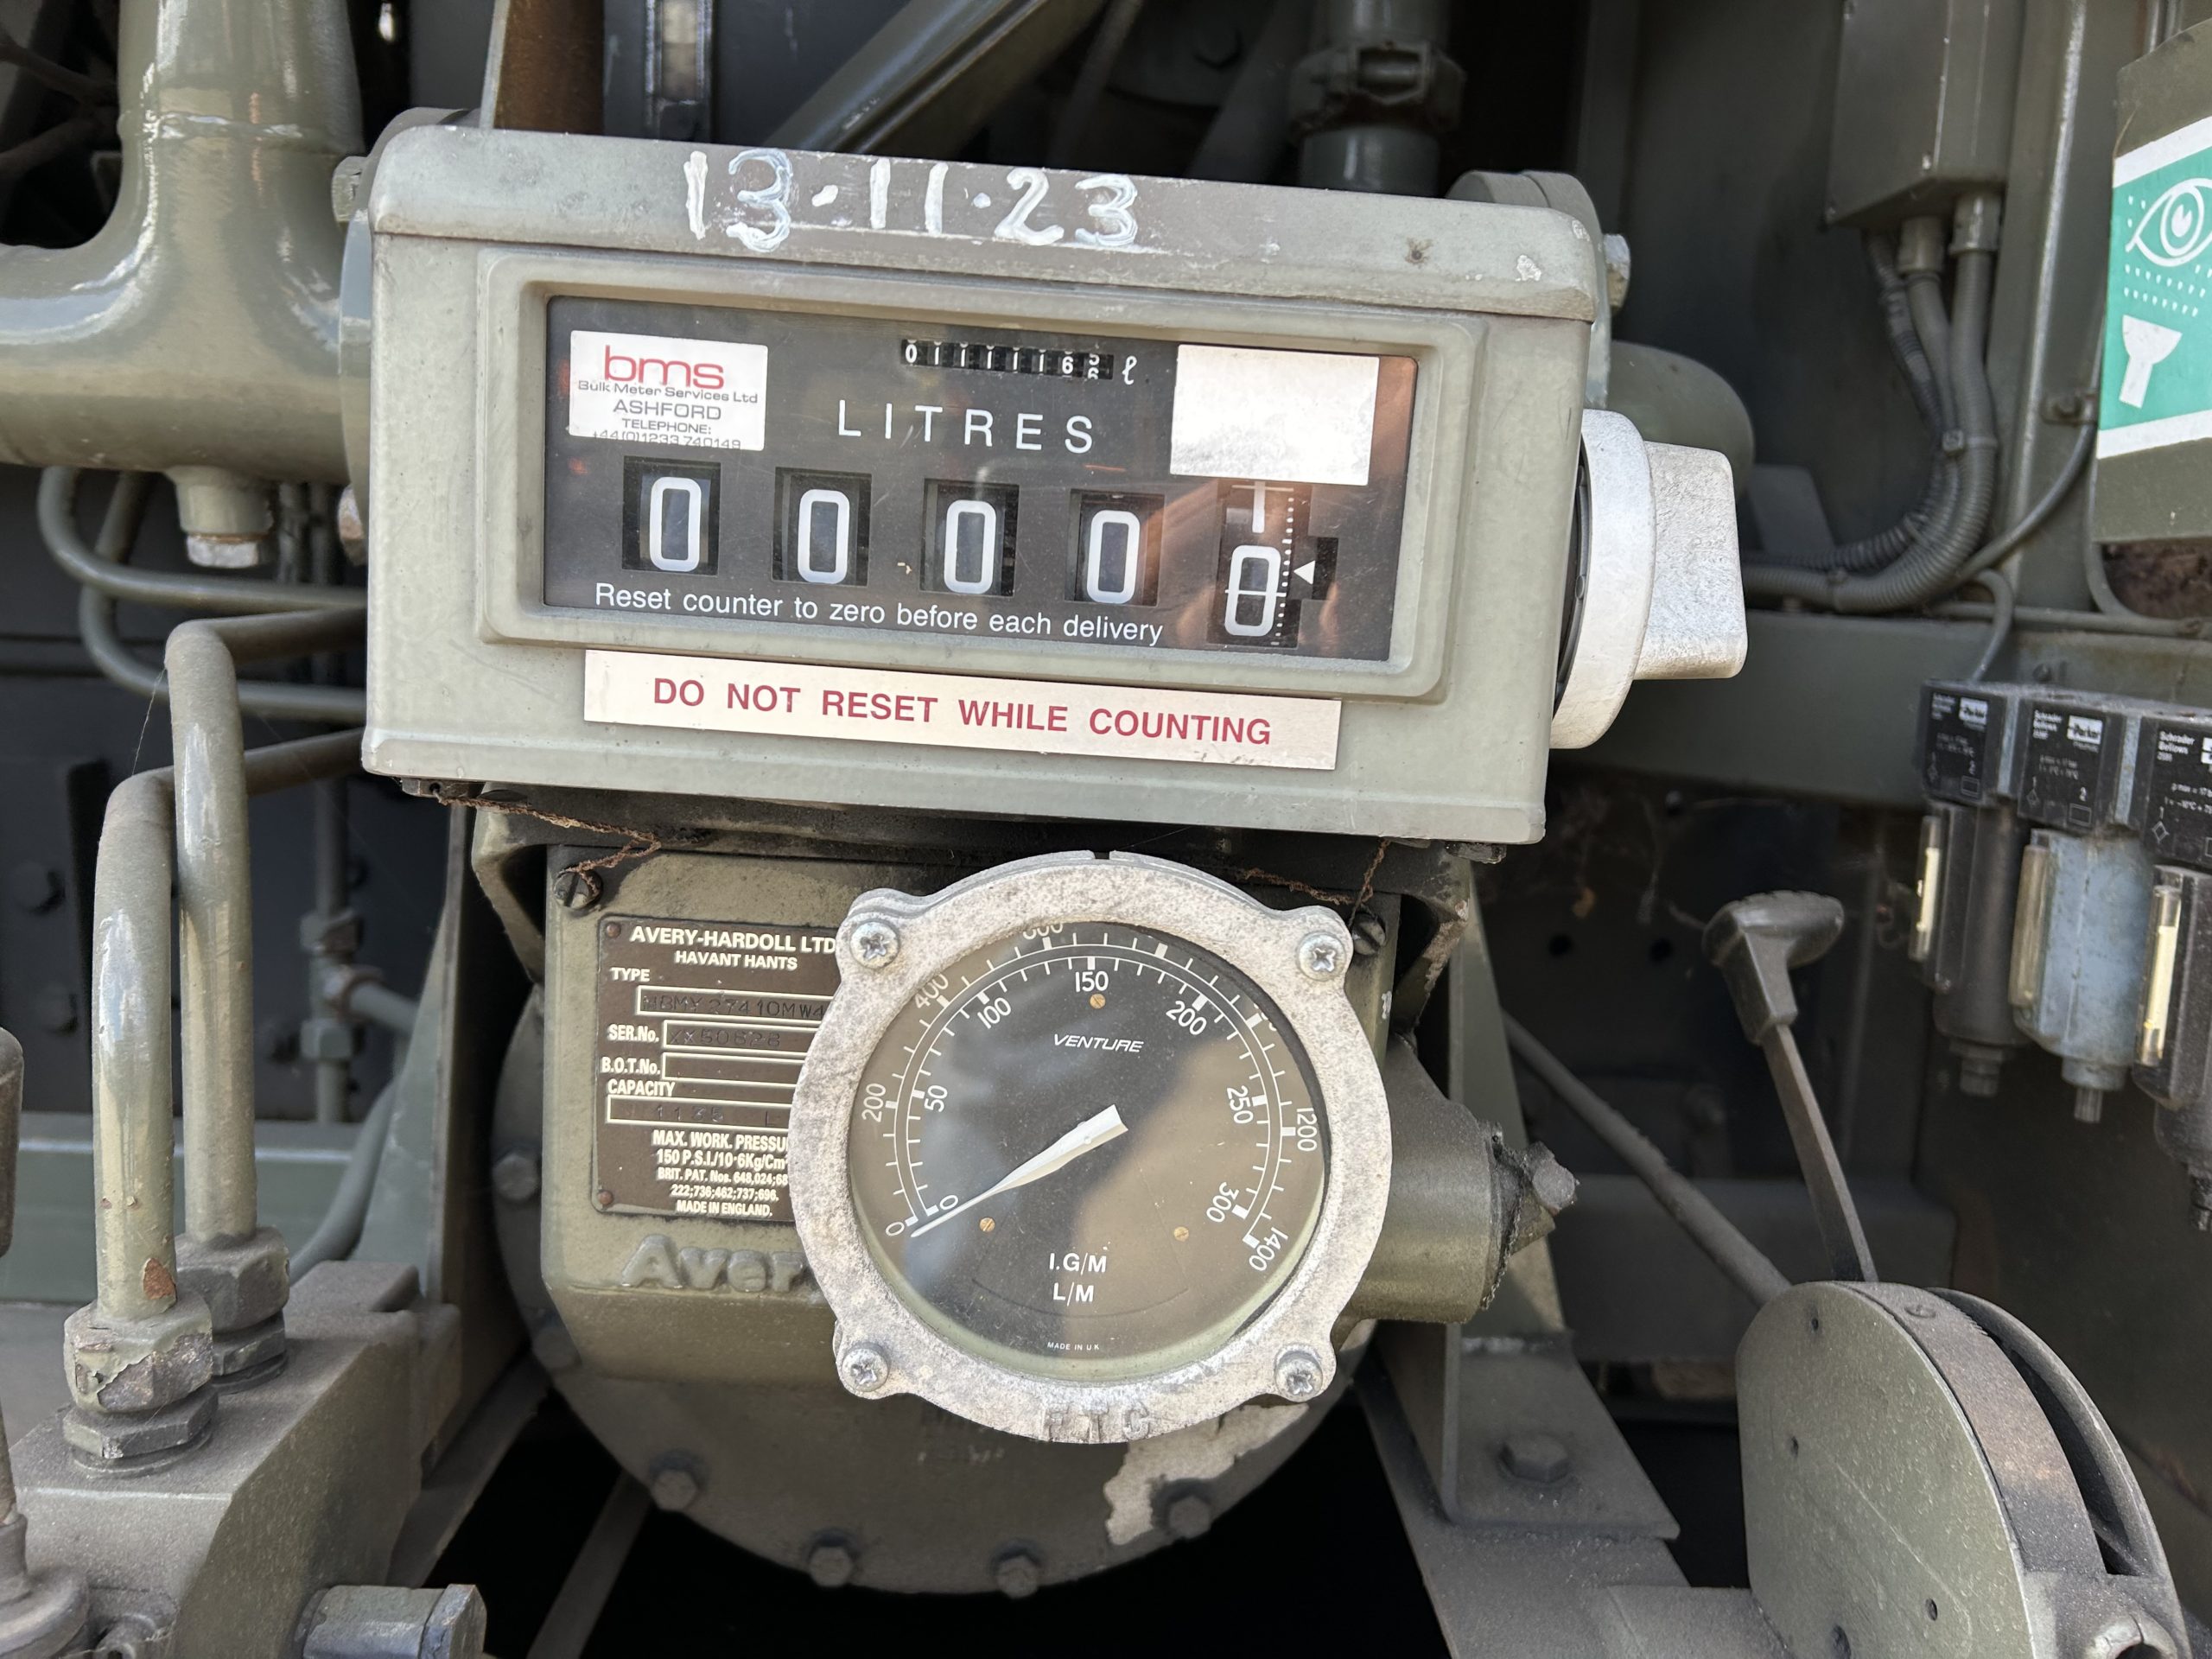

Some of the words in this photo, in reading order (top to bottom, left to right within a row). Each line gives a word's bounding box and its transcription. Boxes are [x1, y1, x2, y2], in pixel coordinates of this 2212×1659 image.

[605, 345, 724, 389] bms
[578, 380, 610, 391] Bulk
[614, 383, 661, 396] Meter
[664, 387, 729, 401] Services
[734, 391, 758, 404] Ltd
[613, 399, 721, 420] ASHFORD
[622, 418, 711, 435] TELEPHONE:
[838, 399, 1093, 454] LITRES
[595, 582, 671, 610] Reset
[683, 593, 784, 617] counter
[794, 597, 818, 619] to
[830, 603, 885, 624] zero
[897, 602, 977, 630] before
[989, 612, 1051, 635] each
[1063, 614, 1163, 646] delivery
[654, 677, 704, 706] DO
[728, 683, 801, 713] NOT
[823, 690, 938, 722] RESET
[958, 699, 1068, 732] WHILE
[1090, 709, 1270, 745] COUNTING
[629, 925, 796, 951] AVERY-HARDOLL
[675, 950, 741, 967] HAVANT
[744, 955, 798, 970] HANTS
[611, 967, 650, 982] TYPE
[1075, 970, 1109, 992] 150
[977, 997, 1012, 1029] 100
[1166, 1001, 1207, 1035] 200
[608, 1023, 659, 1043] SER.No.
[1054, 1033, 1144, 1052] VENTURE
[601, 1057, 660, 1075] B.O.T.No.
[607, 1078, 676, 1097] CAPACITY
[924, 1085, 948, 1112] 50
[861, 1083, 887, 1122] 200
[1227, 1085, 1254, 1124] 250
[652, 1129, 688, 1147] MAX.
[690, 1132, 733, 1149] WORK.
[735, 1135, 788, 1152] PRESSU
[1296, 1108, 1318, 1152] 1200
[657, 1148, 680, 1165] 150
[658, 1166, 683, 1180] BRIT.
[685, 1168, 708, 1182] PAT.
[710, 1170, 732, 1183] Nos.
[677, 1200, 707, 1214] MADE
[709, 1202, 719, 1214] IN
[721, 1202, 772, 1217] ENGLAND.
[939, 1195, 958, 1210] 0
[1206, 1182, 1240, 1223] 300
[886, 1222, 905, 1236] 0
[1249, 1226, 1287, 1272] 1400
[1049, 1252, 1107, 1275] I.G/M
[1053, 1281, 1094, 1306] L/M
[1047, 1342, 1071, 1351] MADE
